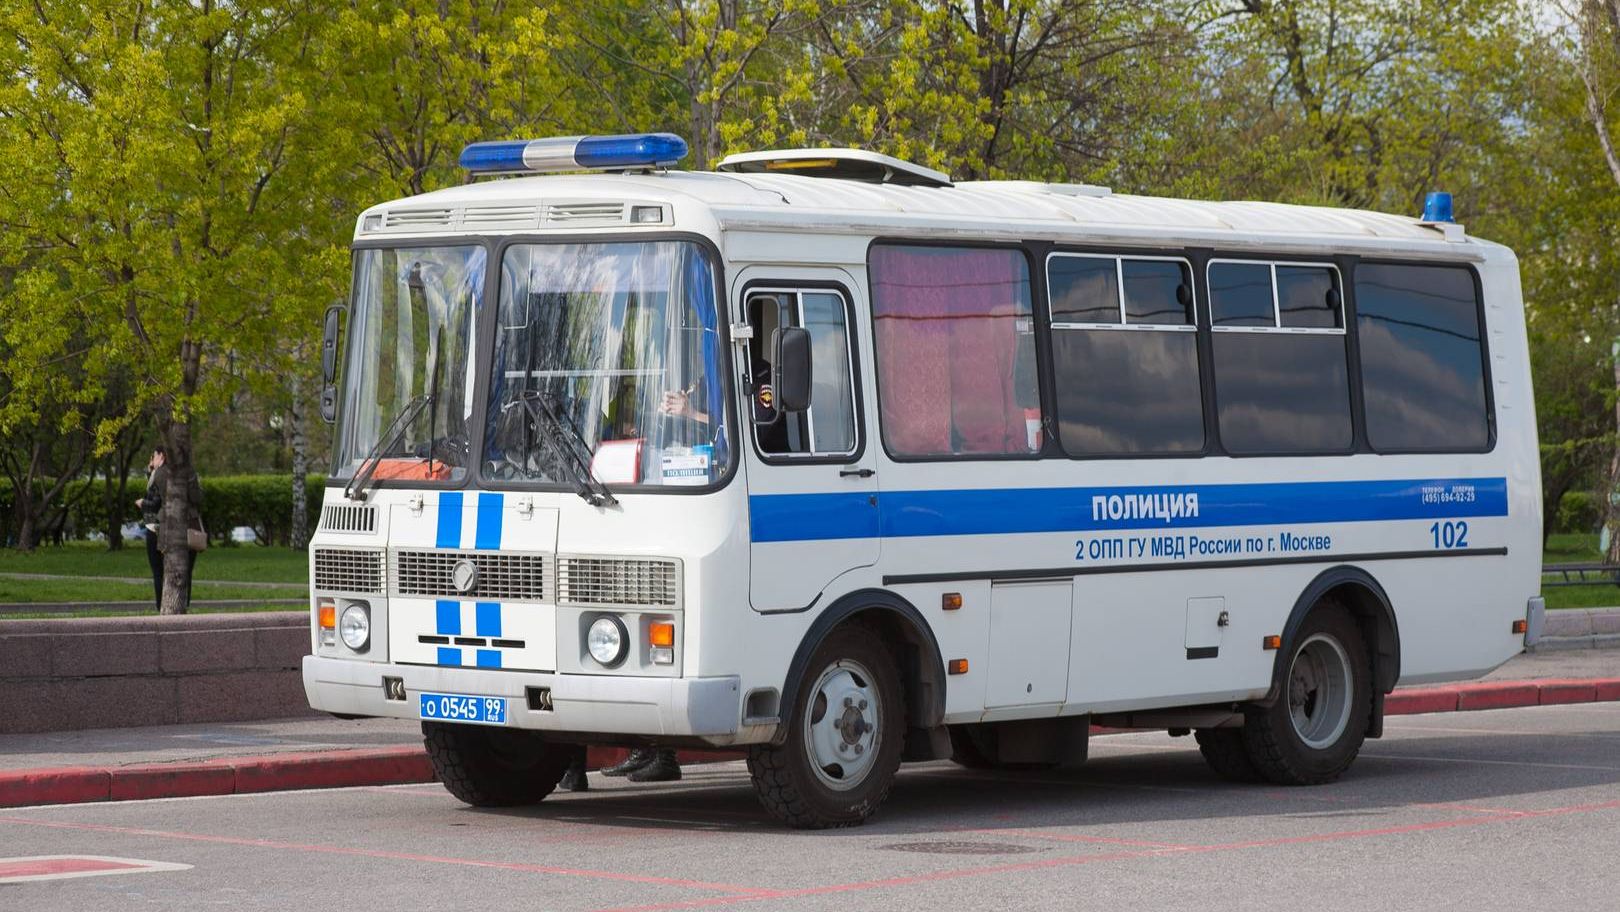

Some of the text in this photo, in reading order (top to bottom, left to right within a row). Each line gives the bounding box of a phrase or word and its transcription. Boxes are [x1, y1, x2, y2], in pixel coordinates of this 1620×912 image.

[1092, 492, 1199, 522] ПОЛИЦИЯ
[1075, 532, 1331, 560] 2 ОПП ГУ МВД России по г. Москве
[1430, 521, 1468, 548] 102
[440, 697, 477, 718] 0545
[485, 699, 501, 715] 99
[487, 714, 499, 722] RUS
